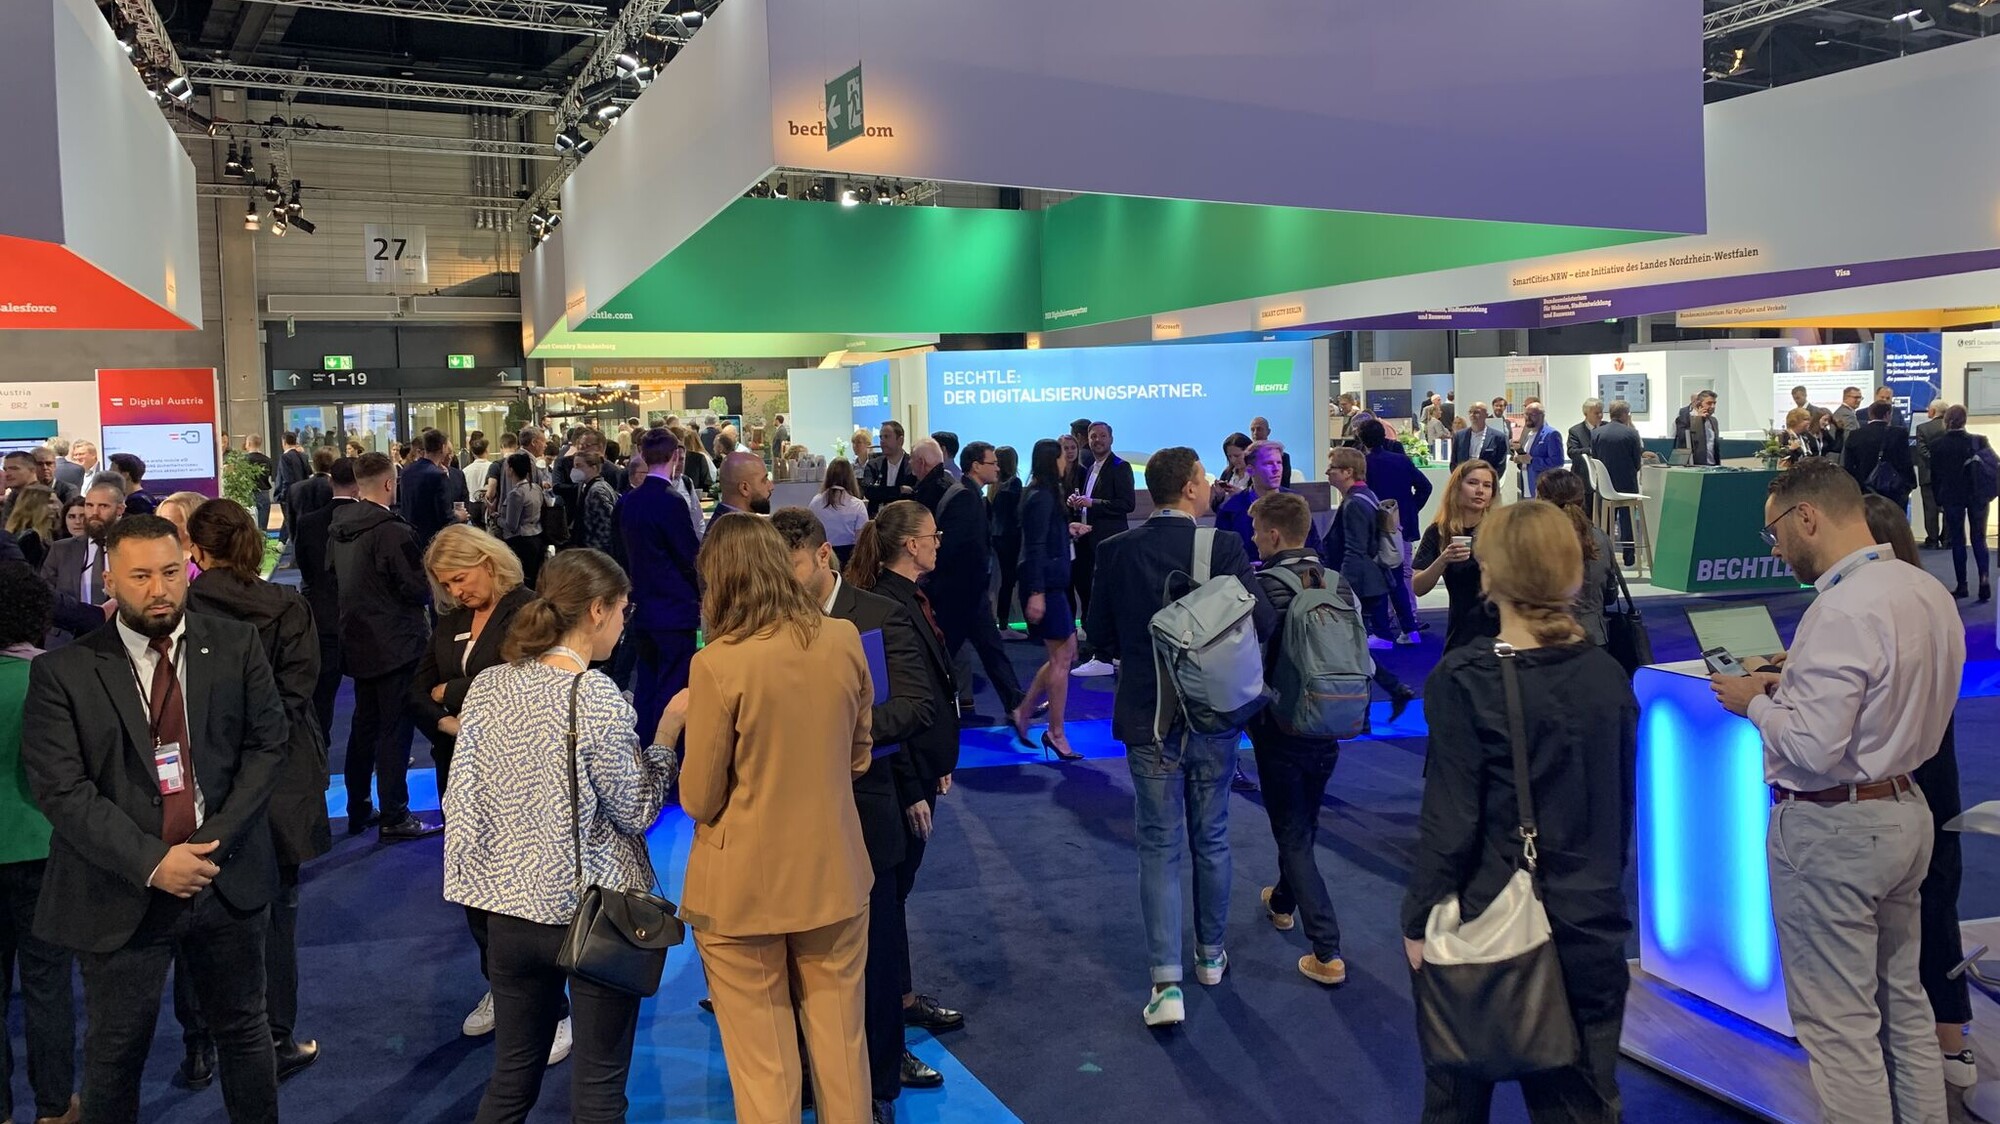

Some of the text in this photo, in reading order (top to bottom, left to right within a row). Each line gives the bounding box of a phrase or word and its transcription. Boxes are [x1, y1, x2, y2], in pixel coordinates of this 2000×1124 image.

[788, 120, 894, 137] bechom
[373, 238, 406, 260] 27
[1512, 272, 1568, 286] SmartCities.NRW
[1575, 269, 1590, 278] eine
[1591, 264, 1624, 276] Initiative
[1626, 262, 1638, 272] des
[1640, 259, 1668, 270] Landes
[1669, 248, 1759, 266] Nordrhein-Westfalen
[0, 302, 57, 312] alesforce
[593, 366, 636, 375] DIGITALE
[667, 366, 712, 374] PROJEKTE
[1382, 367, 1403, 376] ITDZ
[944, 370, 1022, 386] BECHTLE:
[944, 383, 1207, 404] DER DIGITALISIERUNGSPARTNER.
[1254, 384, 1289, 392] BECHTLE
[129, 397, 204, 408] Digital Austria
